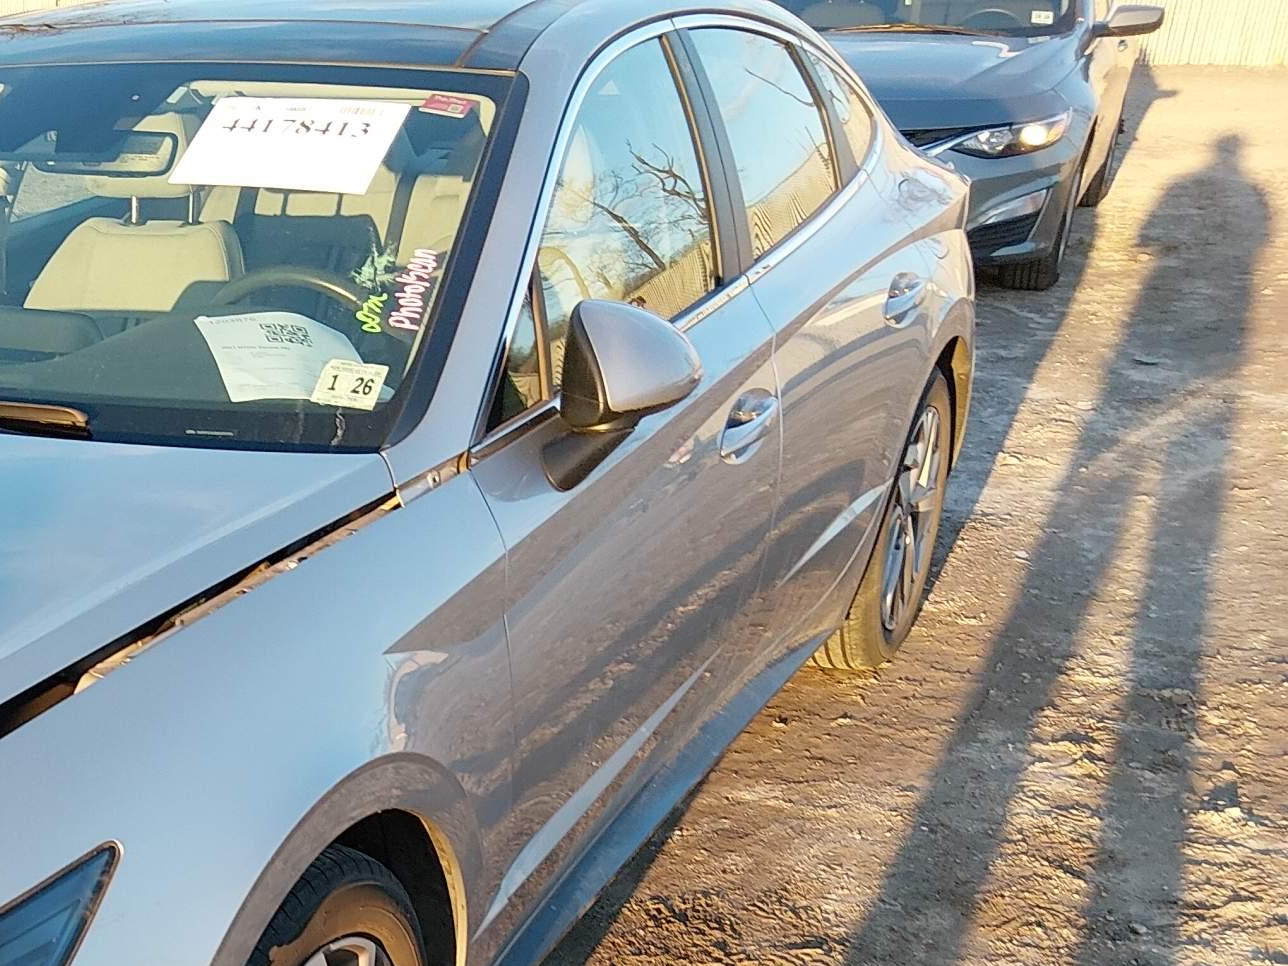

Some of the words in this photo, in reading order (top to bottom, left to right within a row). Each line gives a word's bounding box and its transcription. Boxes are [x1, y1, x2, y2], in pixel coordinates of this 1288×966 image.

[222, 117, 372, 138] 44178413
[327, 374, 339, 391] 1
[350, 376, 375, 395] 26
